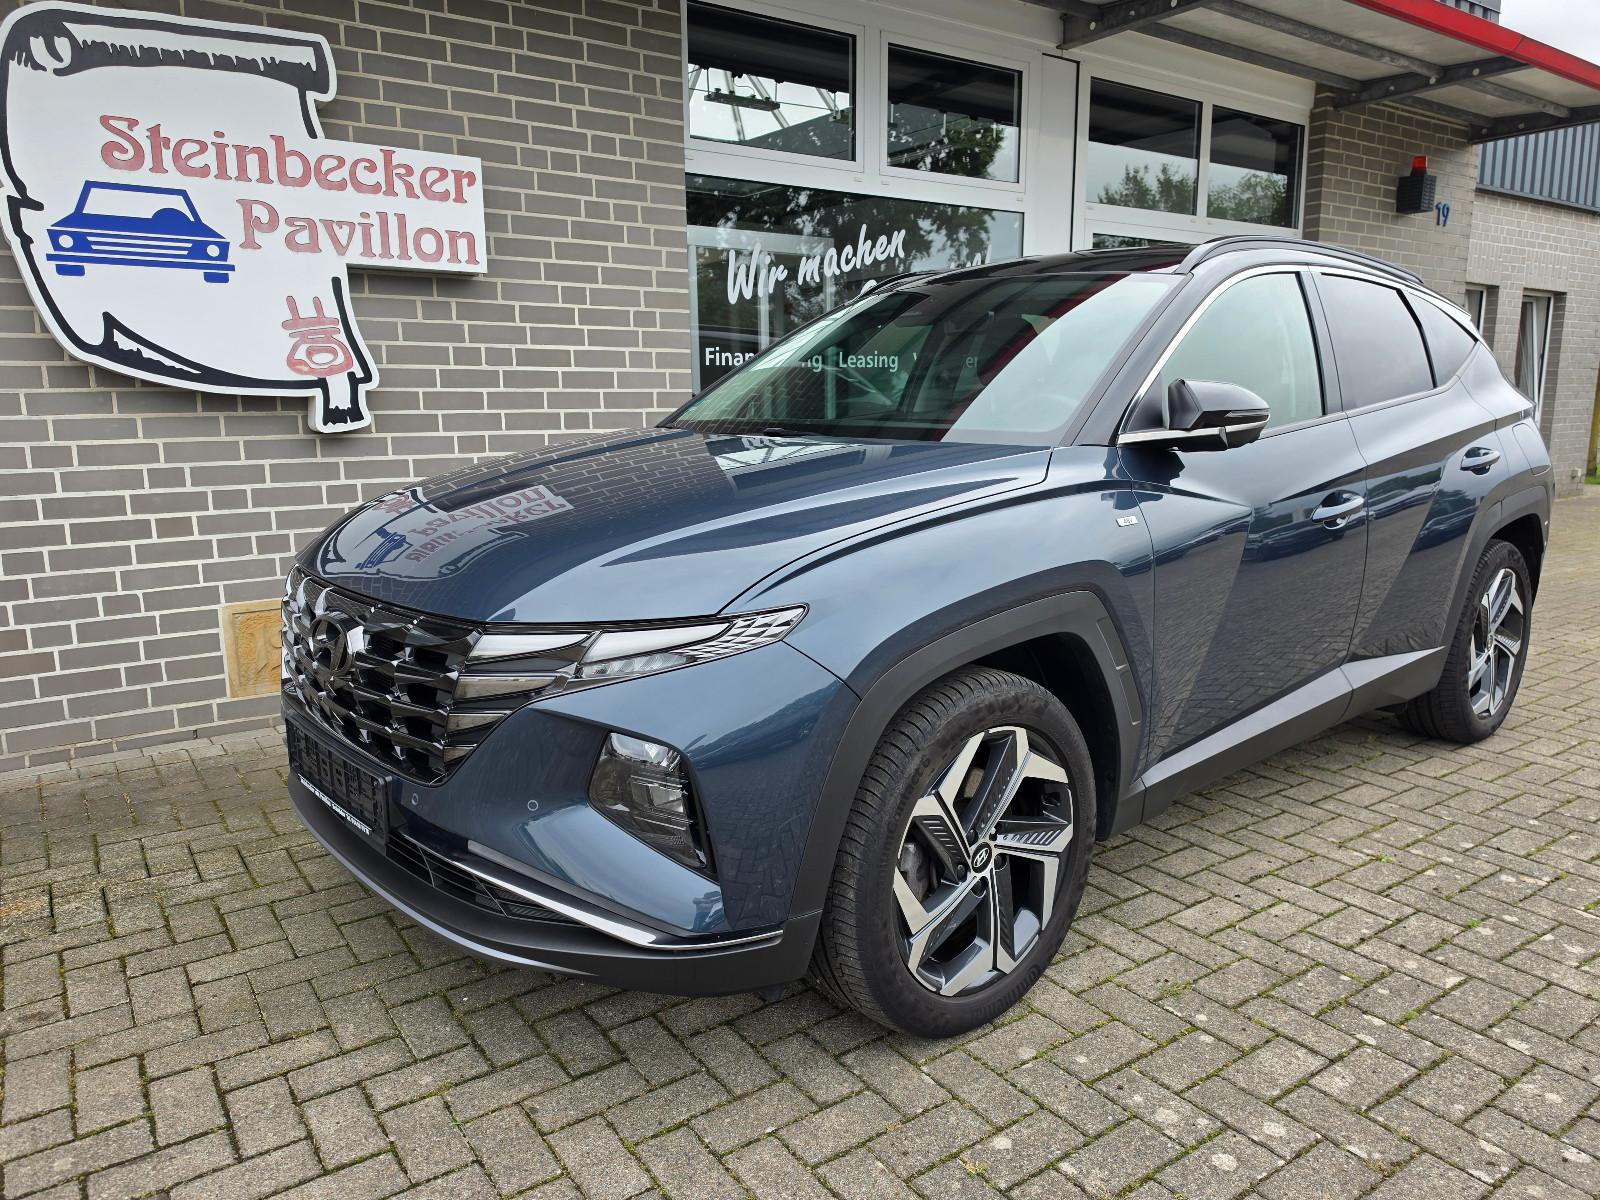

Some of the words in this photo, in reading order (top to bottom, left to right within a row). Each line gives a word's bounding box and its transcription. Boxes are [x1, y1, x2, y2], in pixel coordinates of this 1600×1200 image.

[100, 114, 476, 204] Steinbecker
[236, 199, 481, 265] Pavillon
[1435, 202, 1450, 227] 19
[726, 242, 788, 305] Wir
[797, 223, 907, 286] machen
[839, 350, 899, 373] Leasing
